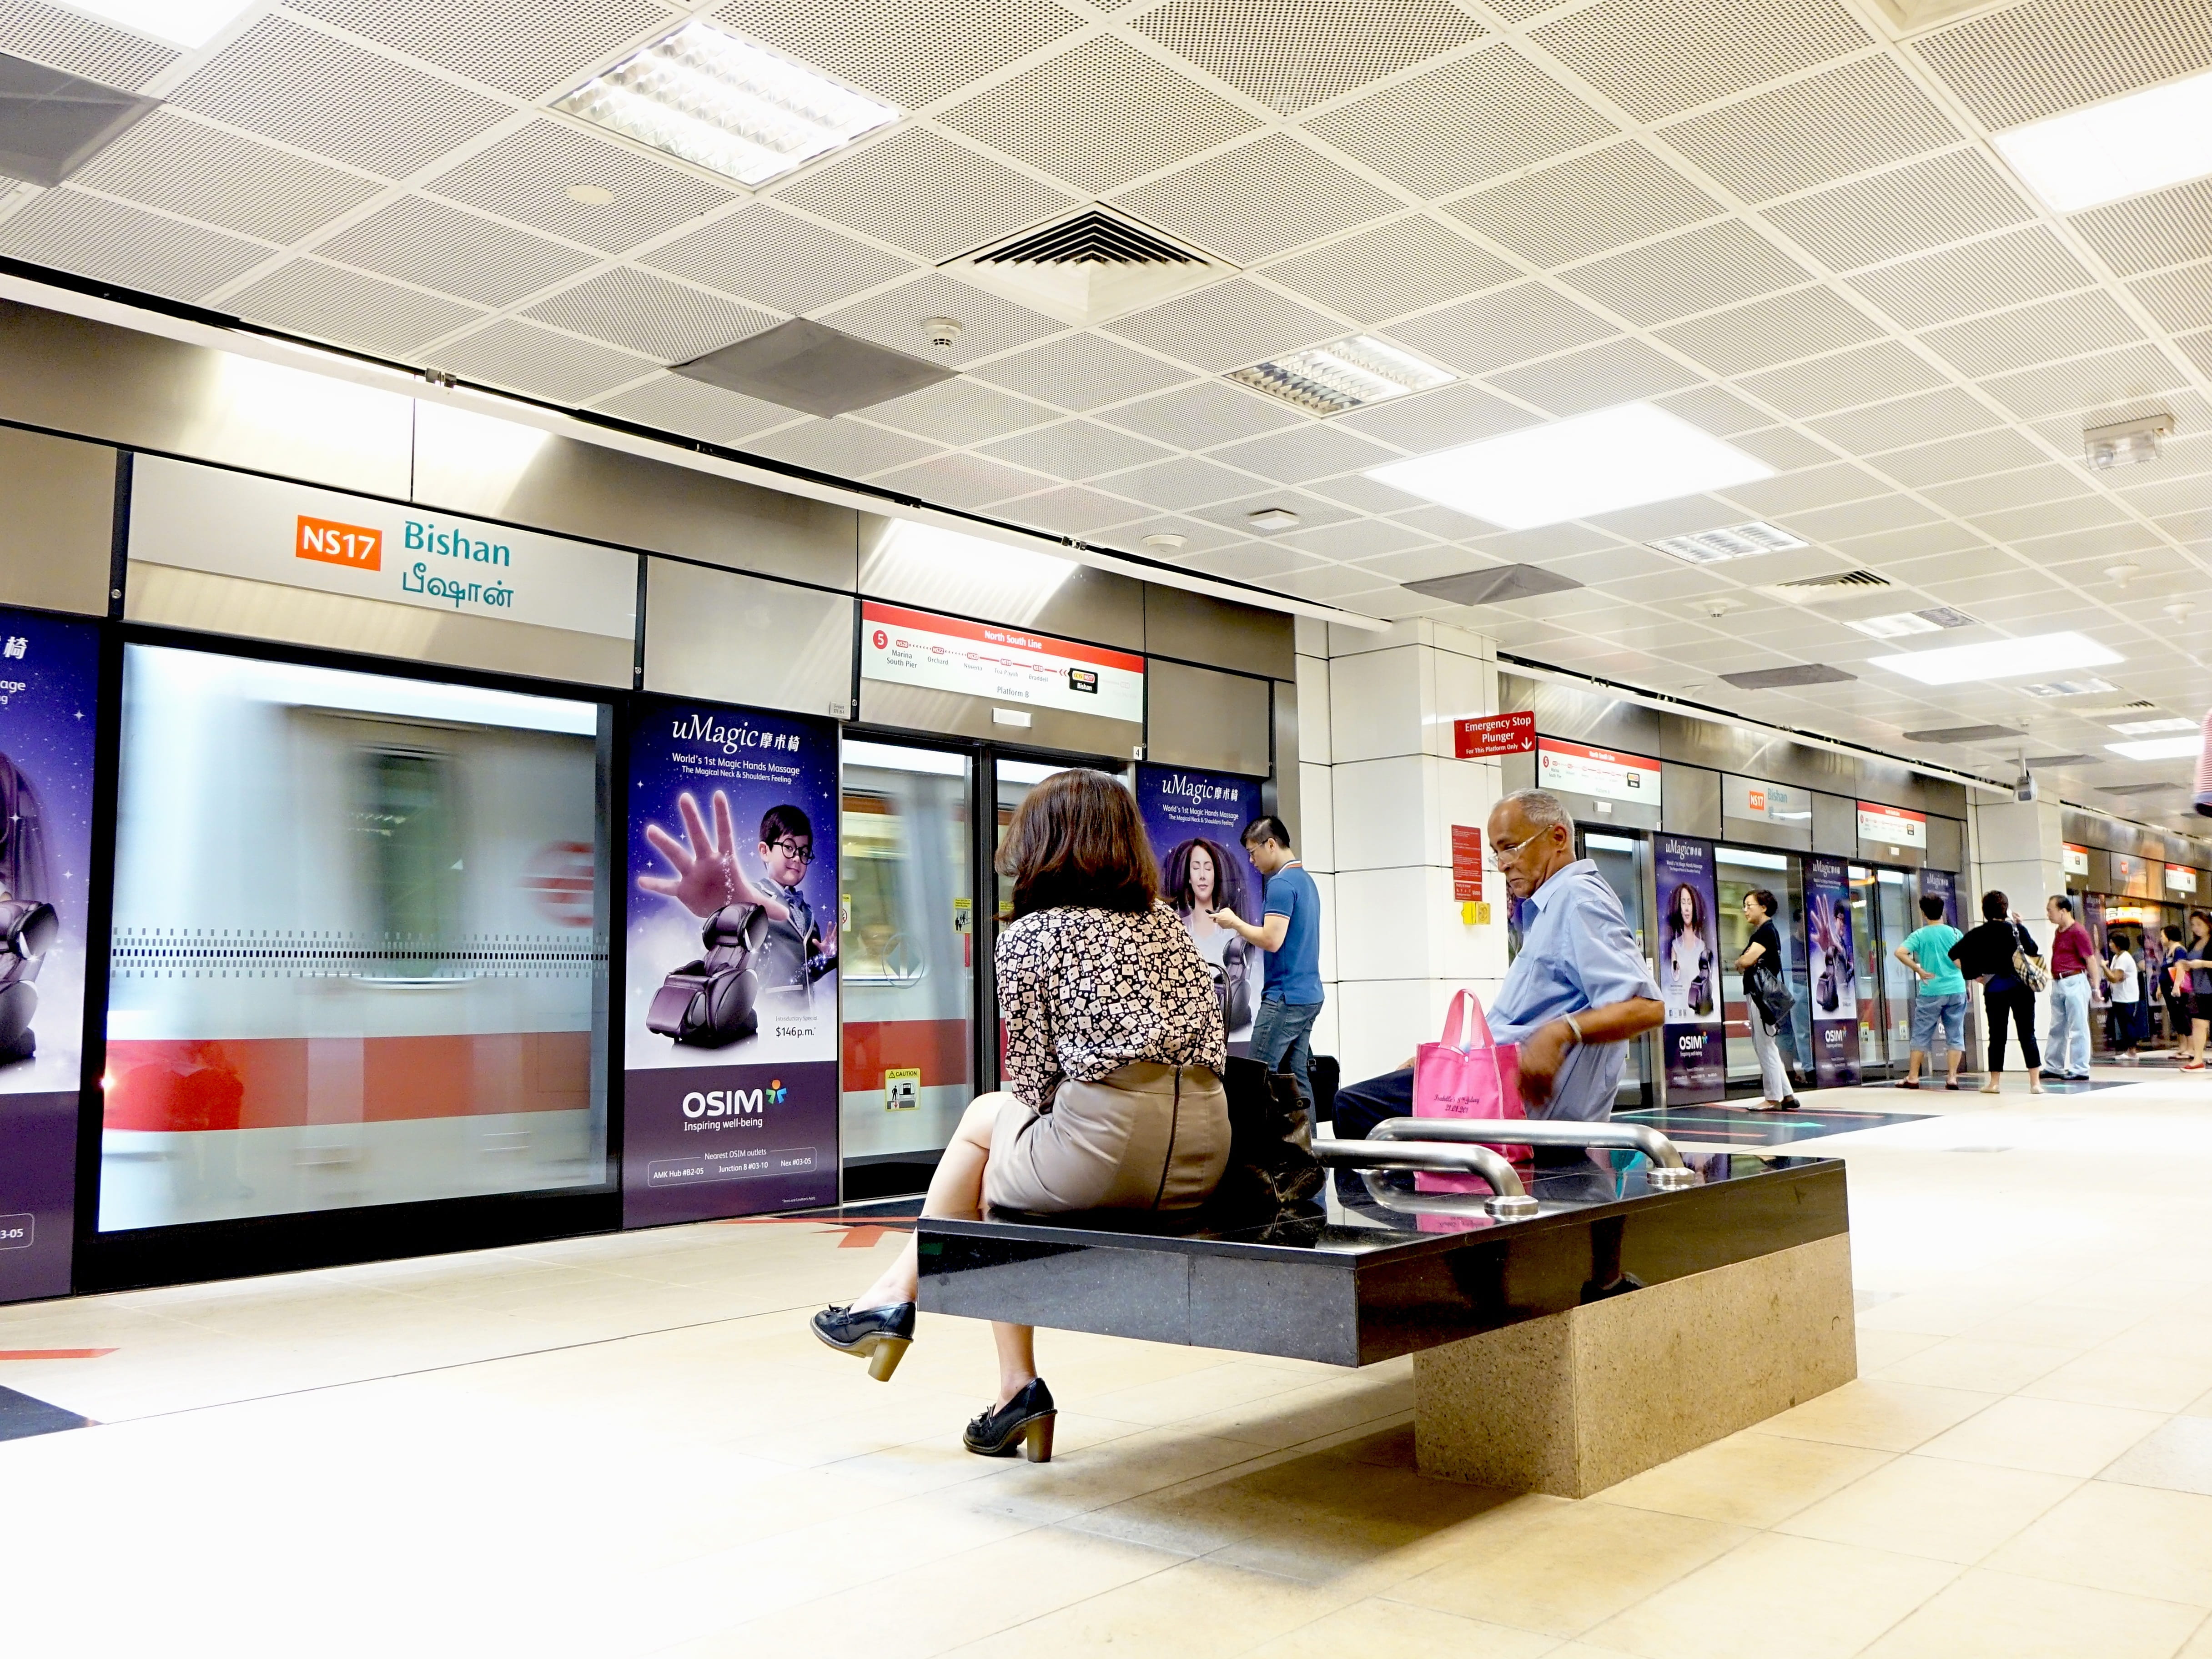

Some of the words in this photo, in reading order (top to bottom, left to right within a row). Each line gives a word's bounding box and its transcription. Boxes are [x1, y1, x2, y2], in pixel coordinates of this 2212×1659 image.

[303, 525, 376, 560] NS17
[404, 520, 510, 567] Bishan
[403, 562, 514, 608] பீஷான்
[877, 633, 885, 646] 5
[985, 630, 1005, 642] North
[1006, 635, 1026, 646] South
[1028, 639, 1042, 649] Line
[0, 636, 29, 659] 椅
[892, 649, 912, 659] Marina
[887, 657, 904, 666] South
[927, 656, 948, 665] Orchard
[964, 663, 982, 671] Novena
[1004, 669, 1019, 678] Payoh
[1029, 674, 1048, 683] Braddell
[997, 686, 1023, 698] Platform
[1077, 682, 1092, 691] Bishan
[1465, 719, 1510, 732] Emergency
[1512, 717, 1531, 727] Stop
[672, 714, 759, 754] uMagic
[1482, 732, 1515, 743] Plunger
[1136, 749, 1139, 757] 4
[1485, 744, 1506, 753] Platform
[672, 752, 702, 764] World's
[704, 756, 715, 766] 1st
[718, 758, 741, 770] Magic
[743, 760, 766, 771] Hands
[768, 763, 800, 776] Massage
[695, 767, 719, 777] Magical
[720, 769, 735, 778] Neck
[742, 772, 770, 781] Shoulders
[771, 774, 791, 784] Feeling
[1162, 774, 1213, 804] uMagic
[1750, 794, 1764, 807] NS17
[1768, 788, 1788, 804] Bishan
[1163, 804, 1181, 813] World's
[1190, 807, 1204, 817] Magic
[1204, 809, 1219, 817] Hands
[1219, 811, 1239, 821] Massage
[1665, 840, 1690, 860] uMagic
[1679, 1035, 1702, 1050] OSIM
[1825, 1030, 1843, 1042] OSIM
[683, 1088, 763, 1118] OSIM
[684, 1121, 721, 1132] Inspiring
[722, 1117, 763, 1128] well-being
[704, 1151, 728, 1160] Nearest
[729, 1150, 746, 1158] OSIM
[719, 1165, 742, 1173] Junction
[748, 1161, 769, 1170] #03-10
[780, 1159, 792, 1167] Nex
[793, 1157, 812, 1166] #03-05
[653, 1171, 668, 1179] AMK
[669, 1169, 682, 1178] Hub
[683, 1167, 704, 1176] #B2-05
